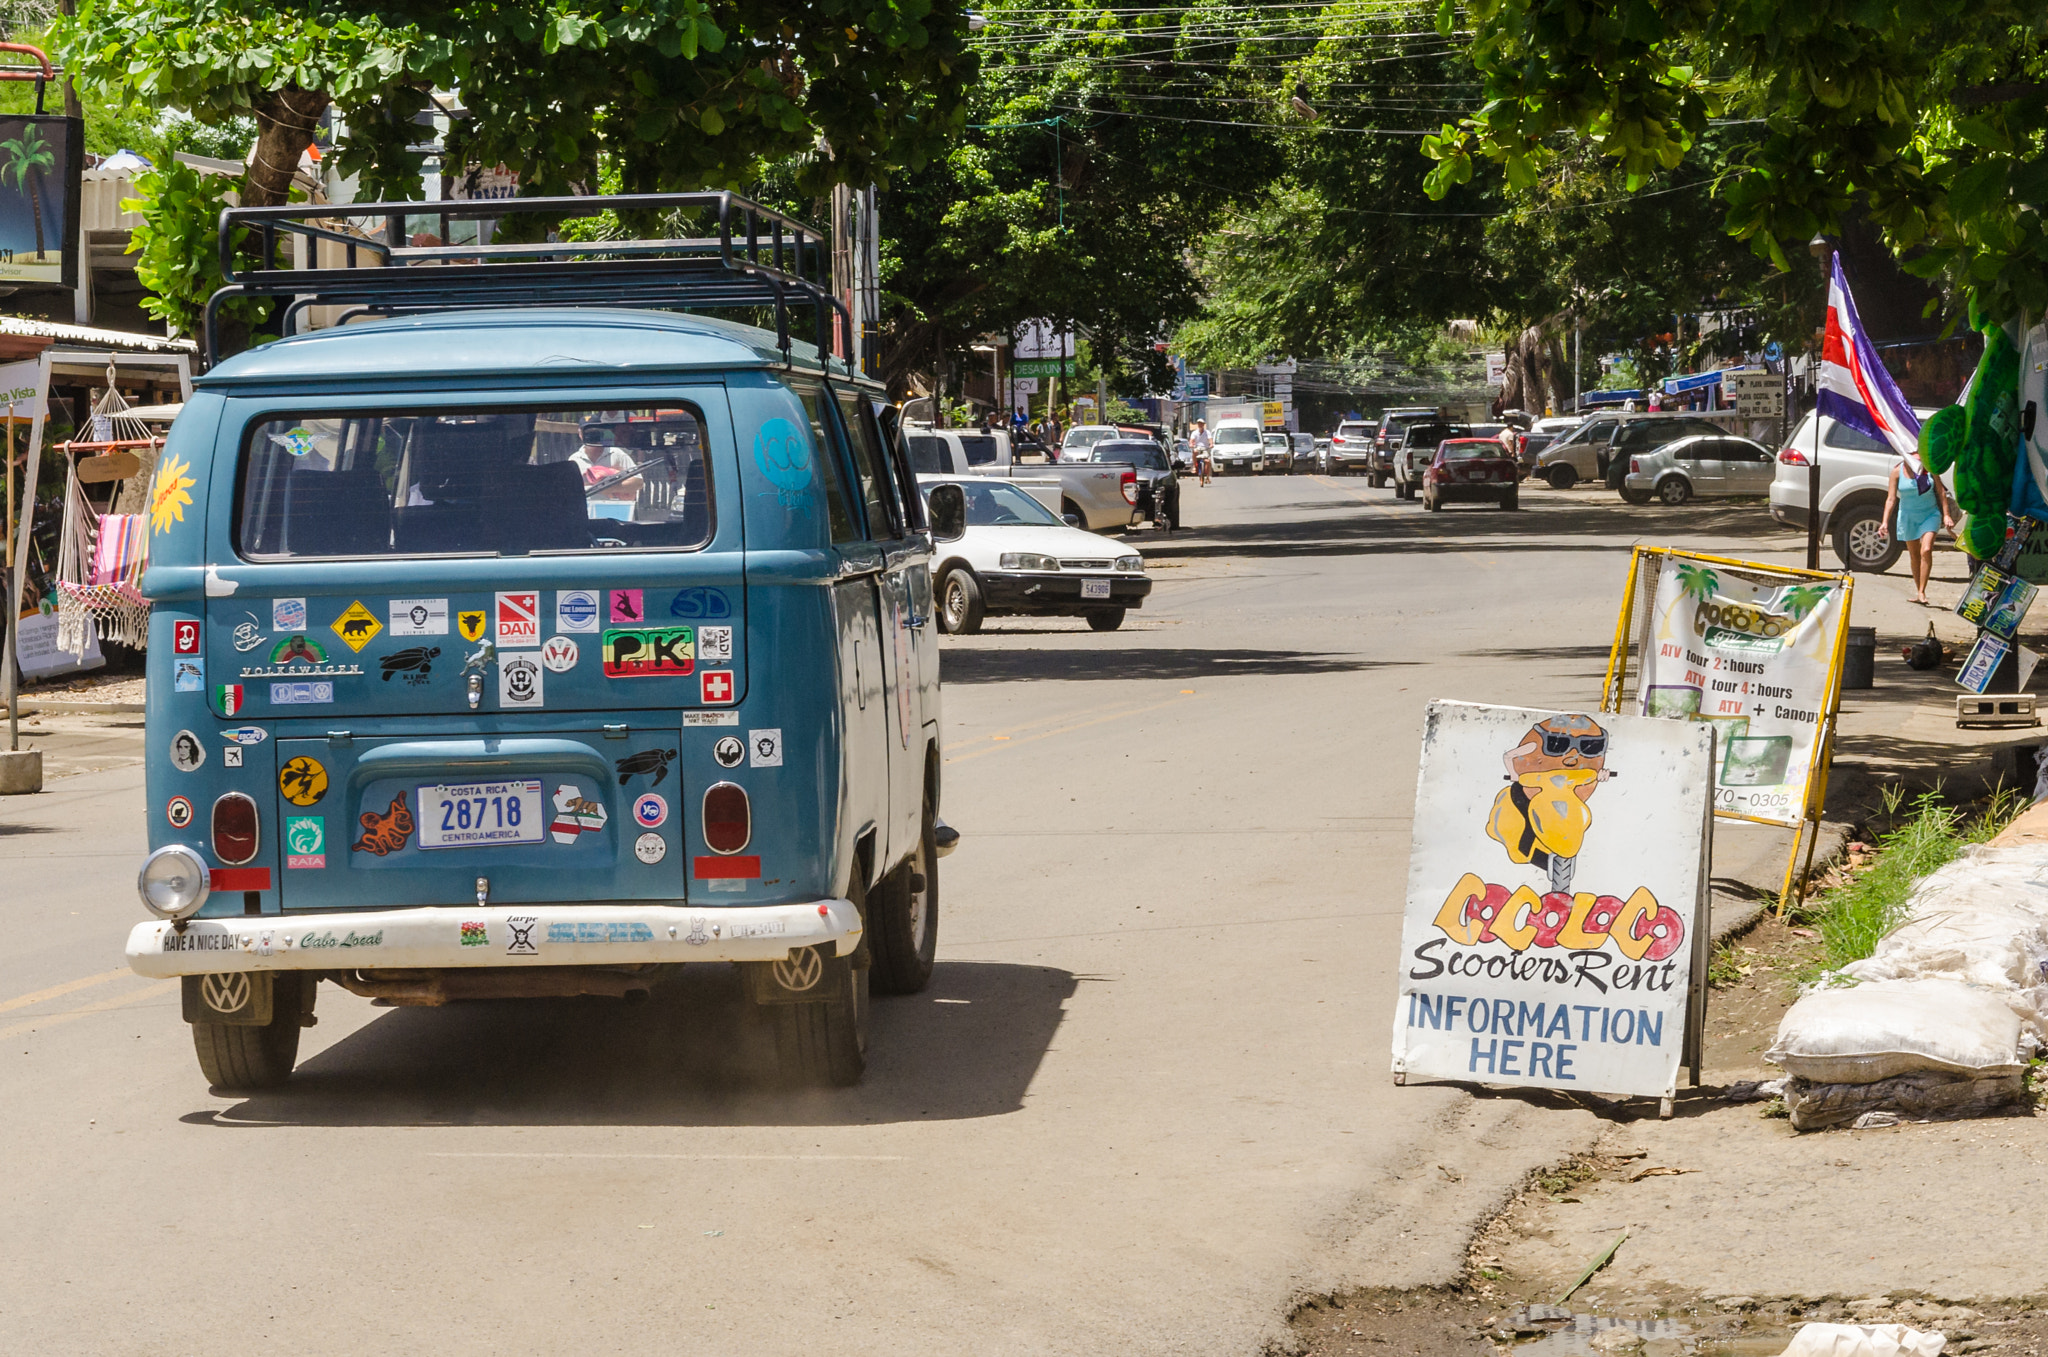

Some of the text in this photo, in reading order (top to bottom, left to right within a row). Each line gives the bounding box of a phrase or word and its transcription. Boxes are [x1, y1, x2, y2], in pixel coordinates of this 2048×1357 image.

[10, 387, 36, 400] Vista
[1962, 599, 1987, 622] PURA
[499, 622, 537, 637] DAN
[718, 629, 730, 657] PADI
[243, 663, 360, 676] VOLKSWAGEN
[1660, 643, 1683, 659] ATV
[1685, 648, 1710, 669] tour
[1729, 658, 1765, 676] hours
[1684, 669, 1706, 688] ATV
[1711, 677, 1738, 694] tour
[1757, 682, 1793, 700] hours
[1963, 665, 1987, 691] PURA
[1718, 698, 1743, 714] ATV
[1775, 704, 1821, 725] Canopy
[450, 785, 508, 797] COSTA RICA
[1714, 786, 1790, 807] 70-0305
[440, 795, 521, 831] 28718
[442, 830, 520, 842] CENTROAMERICA
[163, 933, 241, 952] HAVE A NICE DAY
[300, 930, 384, 949] Cabo Local
[1409, 938, 1678, 996] Scooters Rent
[1408, 992, 1664, 1047] INFORMATION
[1468, 1037, 1578, 1081] HERE
